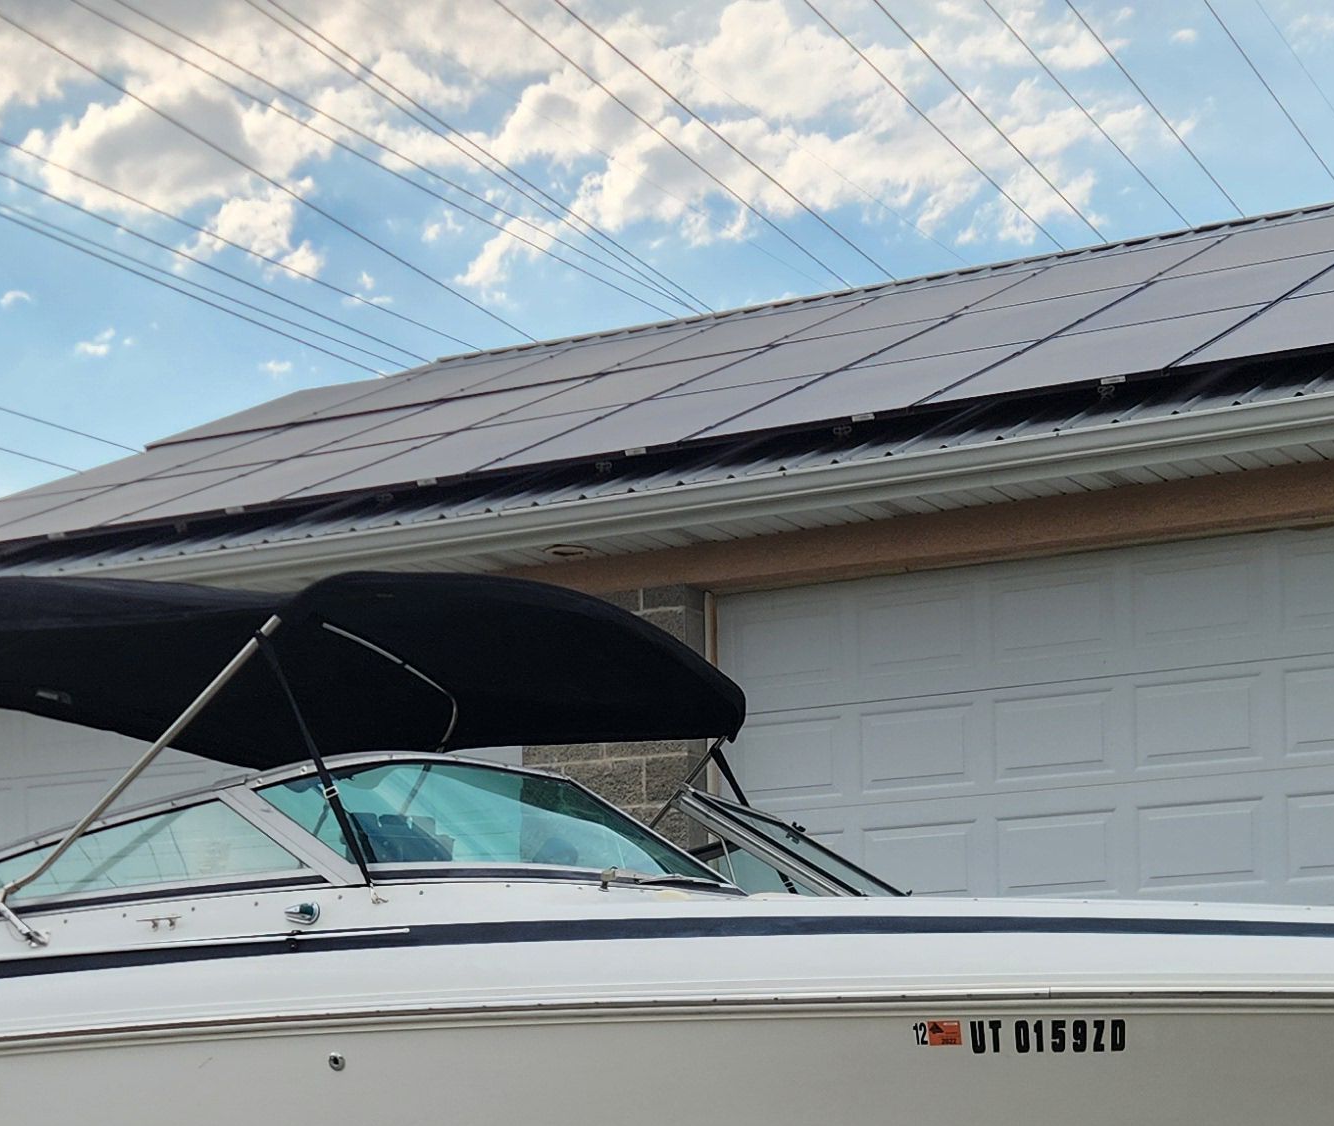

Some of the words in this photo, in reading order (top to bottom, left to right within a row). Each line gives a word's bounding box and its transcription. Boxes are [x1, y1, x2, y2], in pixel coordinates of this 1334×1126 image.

[913, 1022, 928, 1045] 12
[970, 1020, 1002, 1054] UT
[1014, 1019, 1126, 1053] 0159ZD
